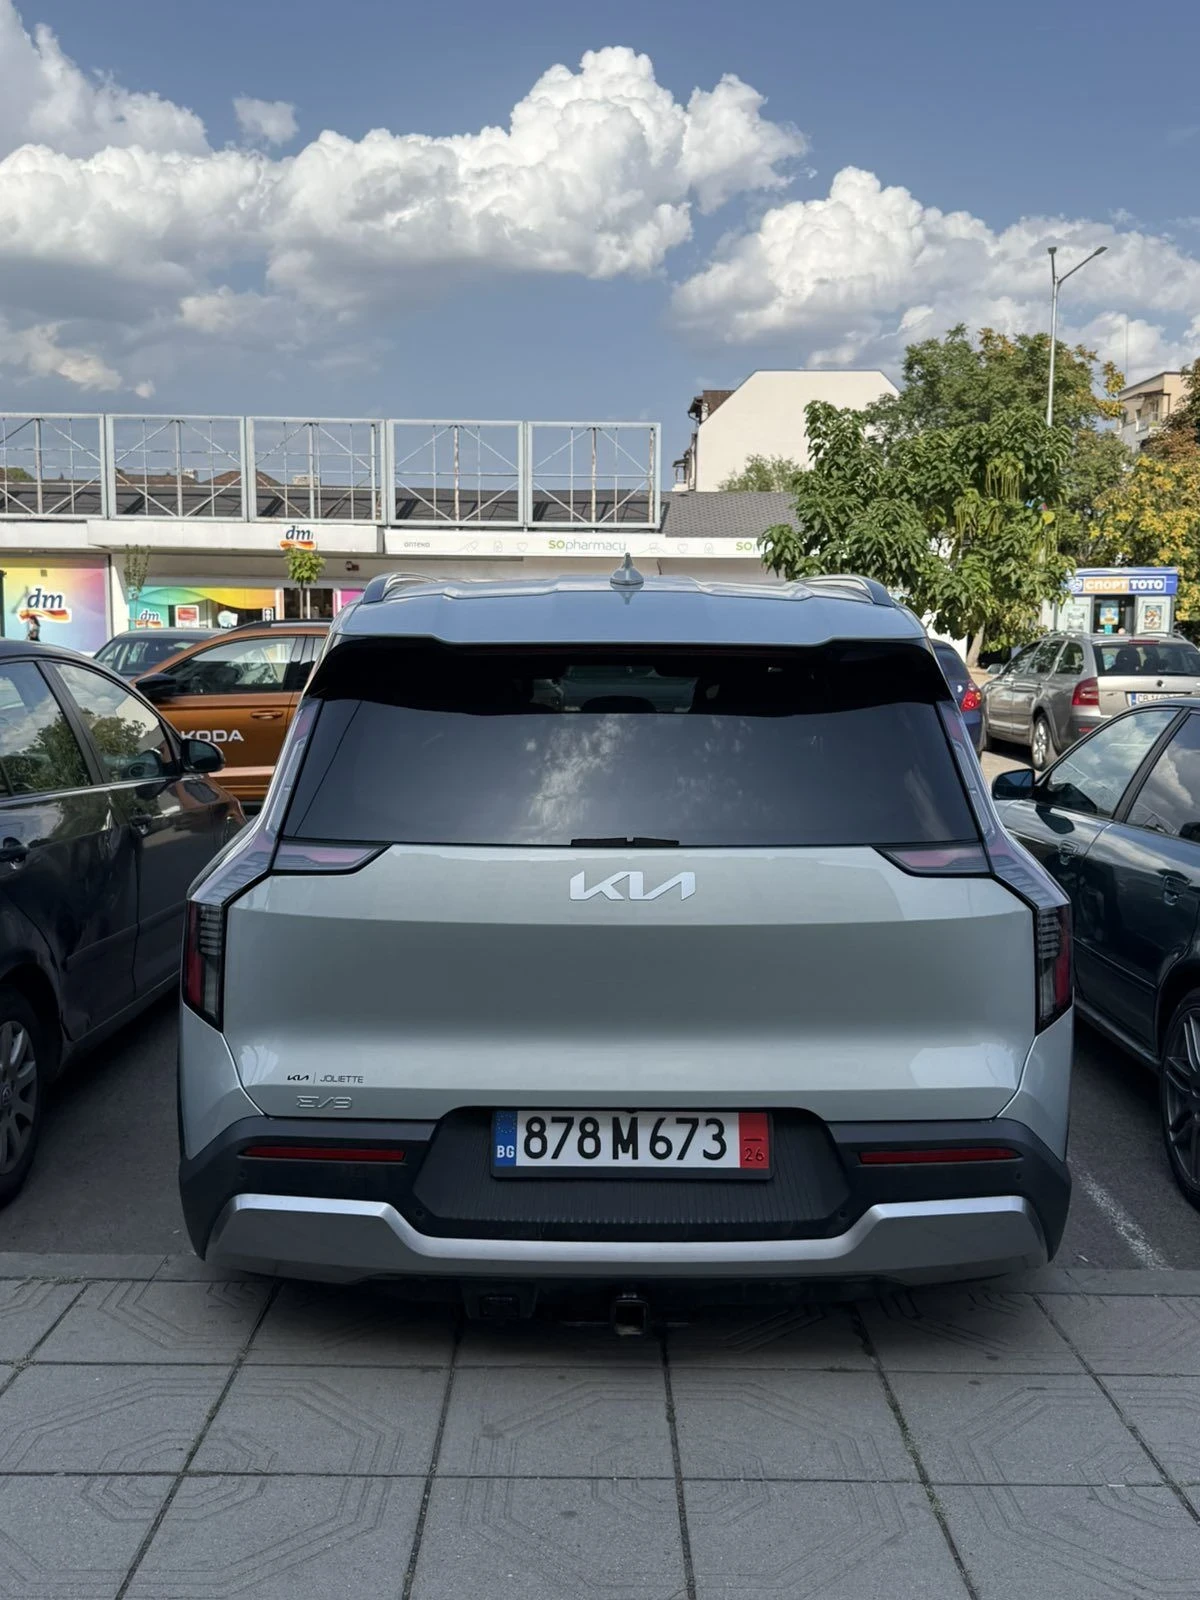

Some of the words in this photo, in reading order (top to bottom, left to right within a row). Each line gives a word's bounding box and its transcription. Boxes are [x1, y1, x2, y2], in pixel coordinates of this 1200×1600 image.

[285, 525, 314, 540] dm
[1085, 580, 1128, 591] СПОРТ
[1130, 580, 1164, 590] ТОТО
[27, 588, 64, 609] dm
[140, 611, 160, 621] dm
[180, 729, 245, 742] KODA
[569, 870, 696, 901] KIA
[319, 1074, 364, 1084] JOLIETTE
[496, 1145, 516, 1158] BG
[743, 1147, 765, 1162] 26
